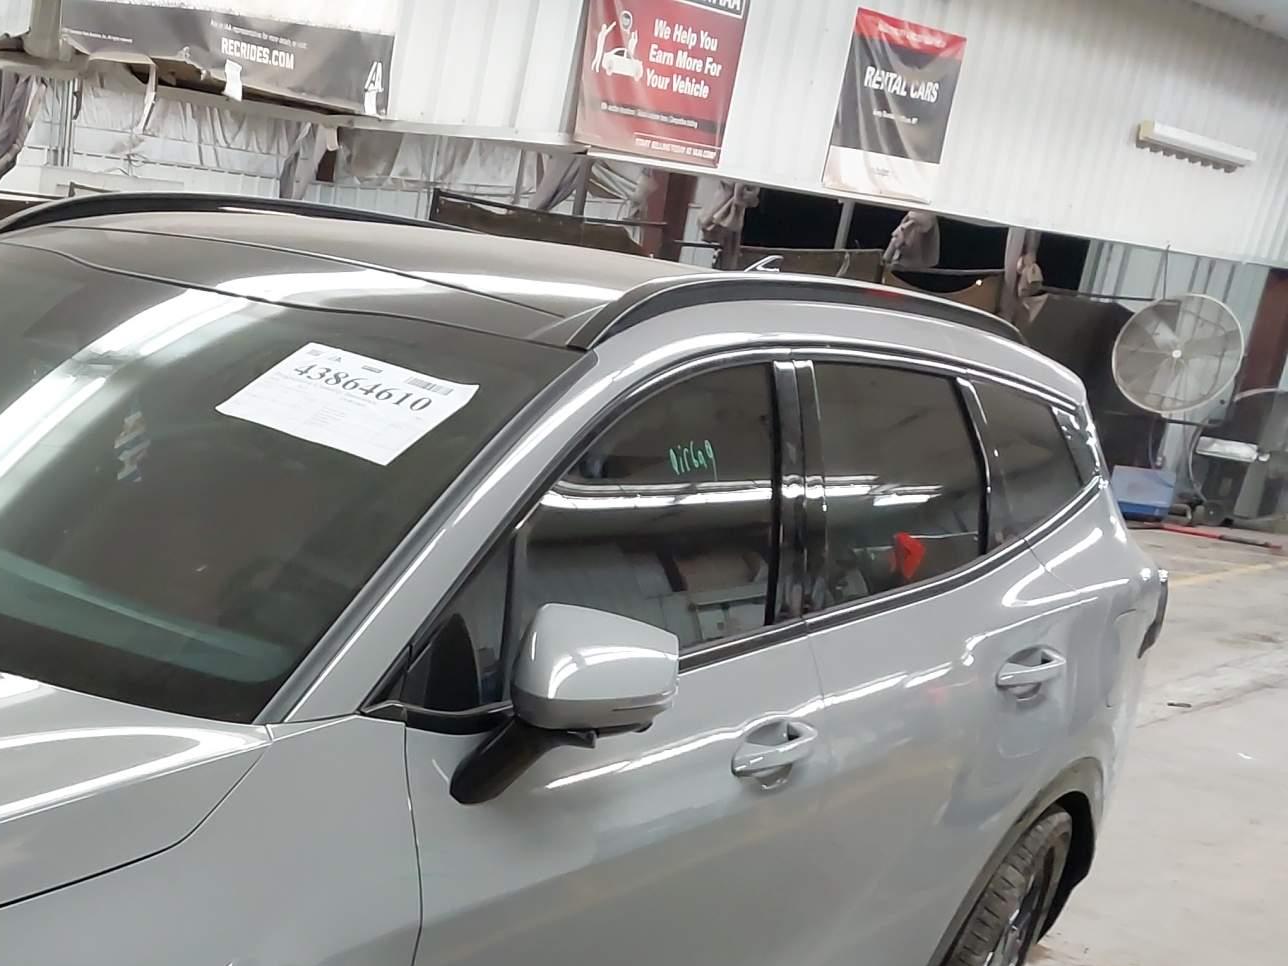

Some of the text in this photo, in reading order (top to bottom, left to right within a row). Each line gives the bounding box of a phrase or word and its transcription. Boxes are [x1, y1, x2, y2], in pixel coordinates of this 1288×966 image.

[654, 18, 718, 52] We Help You
[221, 37, 295, 70] RECRIDES.COM
[649, 44, 722, 77] Earn More For
[646, 68, 710, 99] Your Vehicle
[864, 66, 940, 103] RENTAL CARS
[294, 363, 432, 412] 43864610
